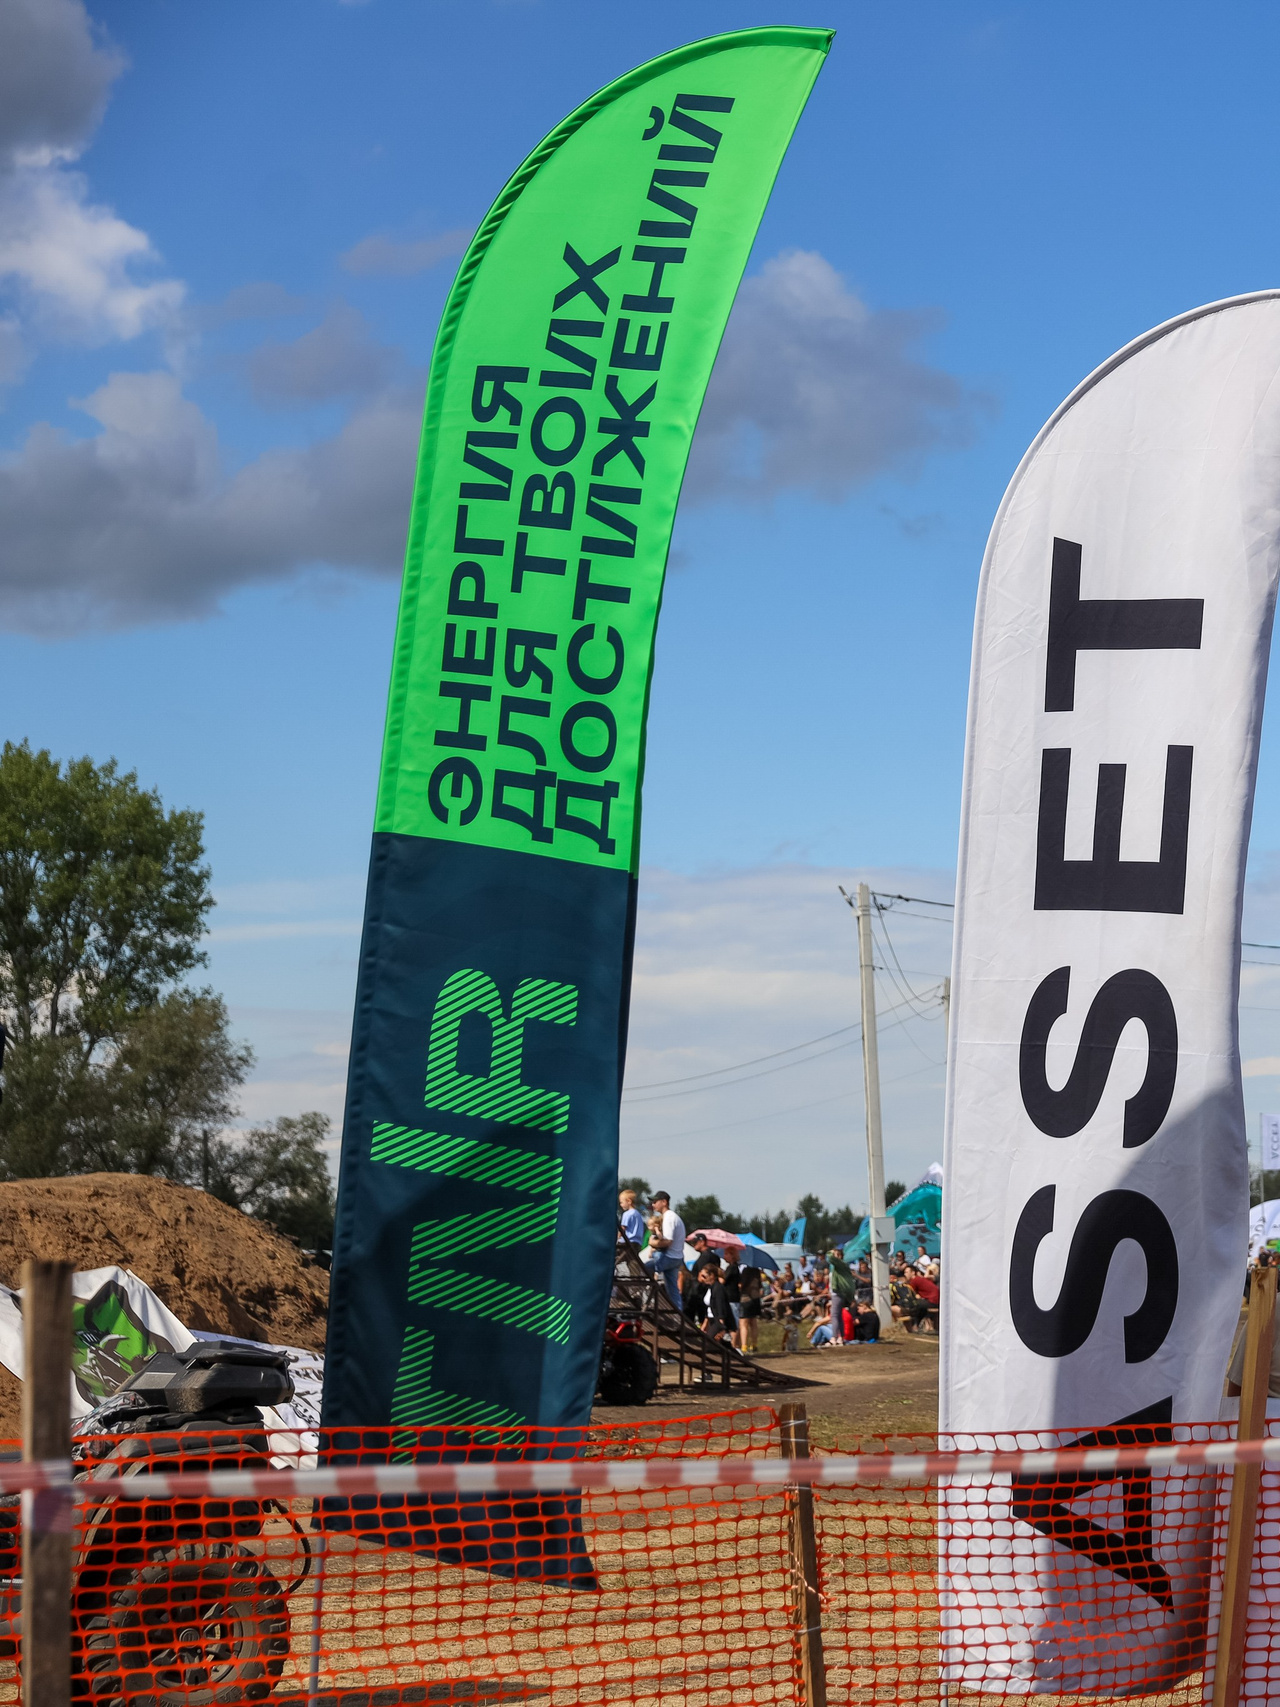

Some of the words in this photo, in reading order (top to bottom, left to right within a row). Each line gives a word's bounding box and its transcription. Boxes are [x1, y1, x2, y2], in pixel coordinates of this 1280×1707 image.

[428, 364, 530, 827] ЭНЕРГИЯ
[511, 241, 622, 594] ТВОИХ
[554, 92, 736, 855] ДОСТИЖЕНИЙ
[491, 626, 558, 844] ДЛЯ
[1009, 536, 1205, 1615] ASSET
